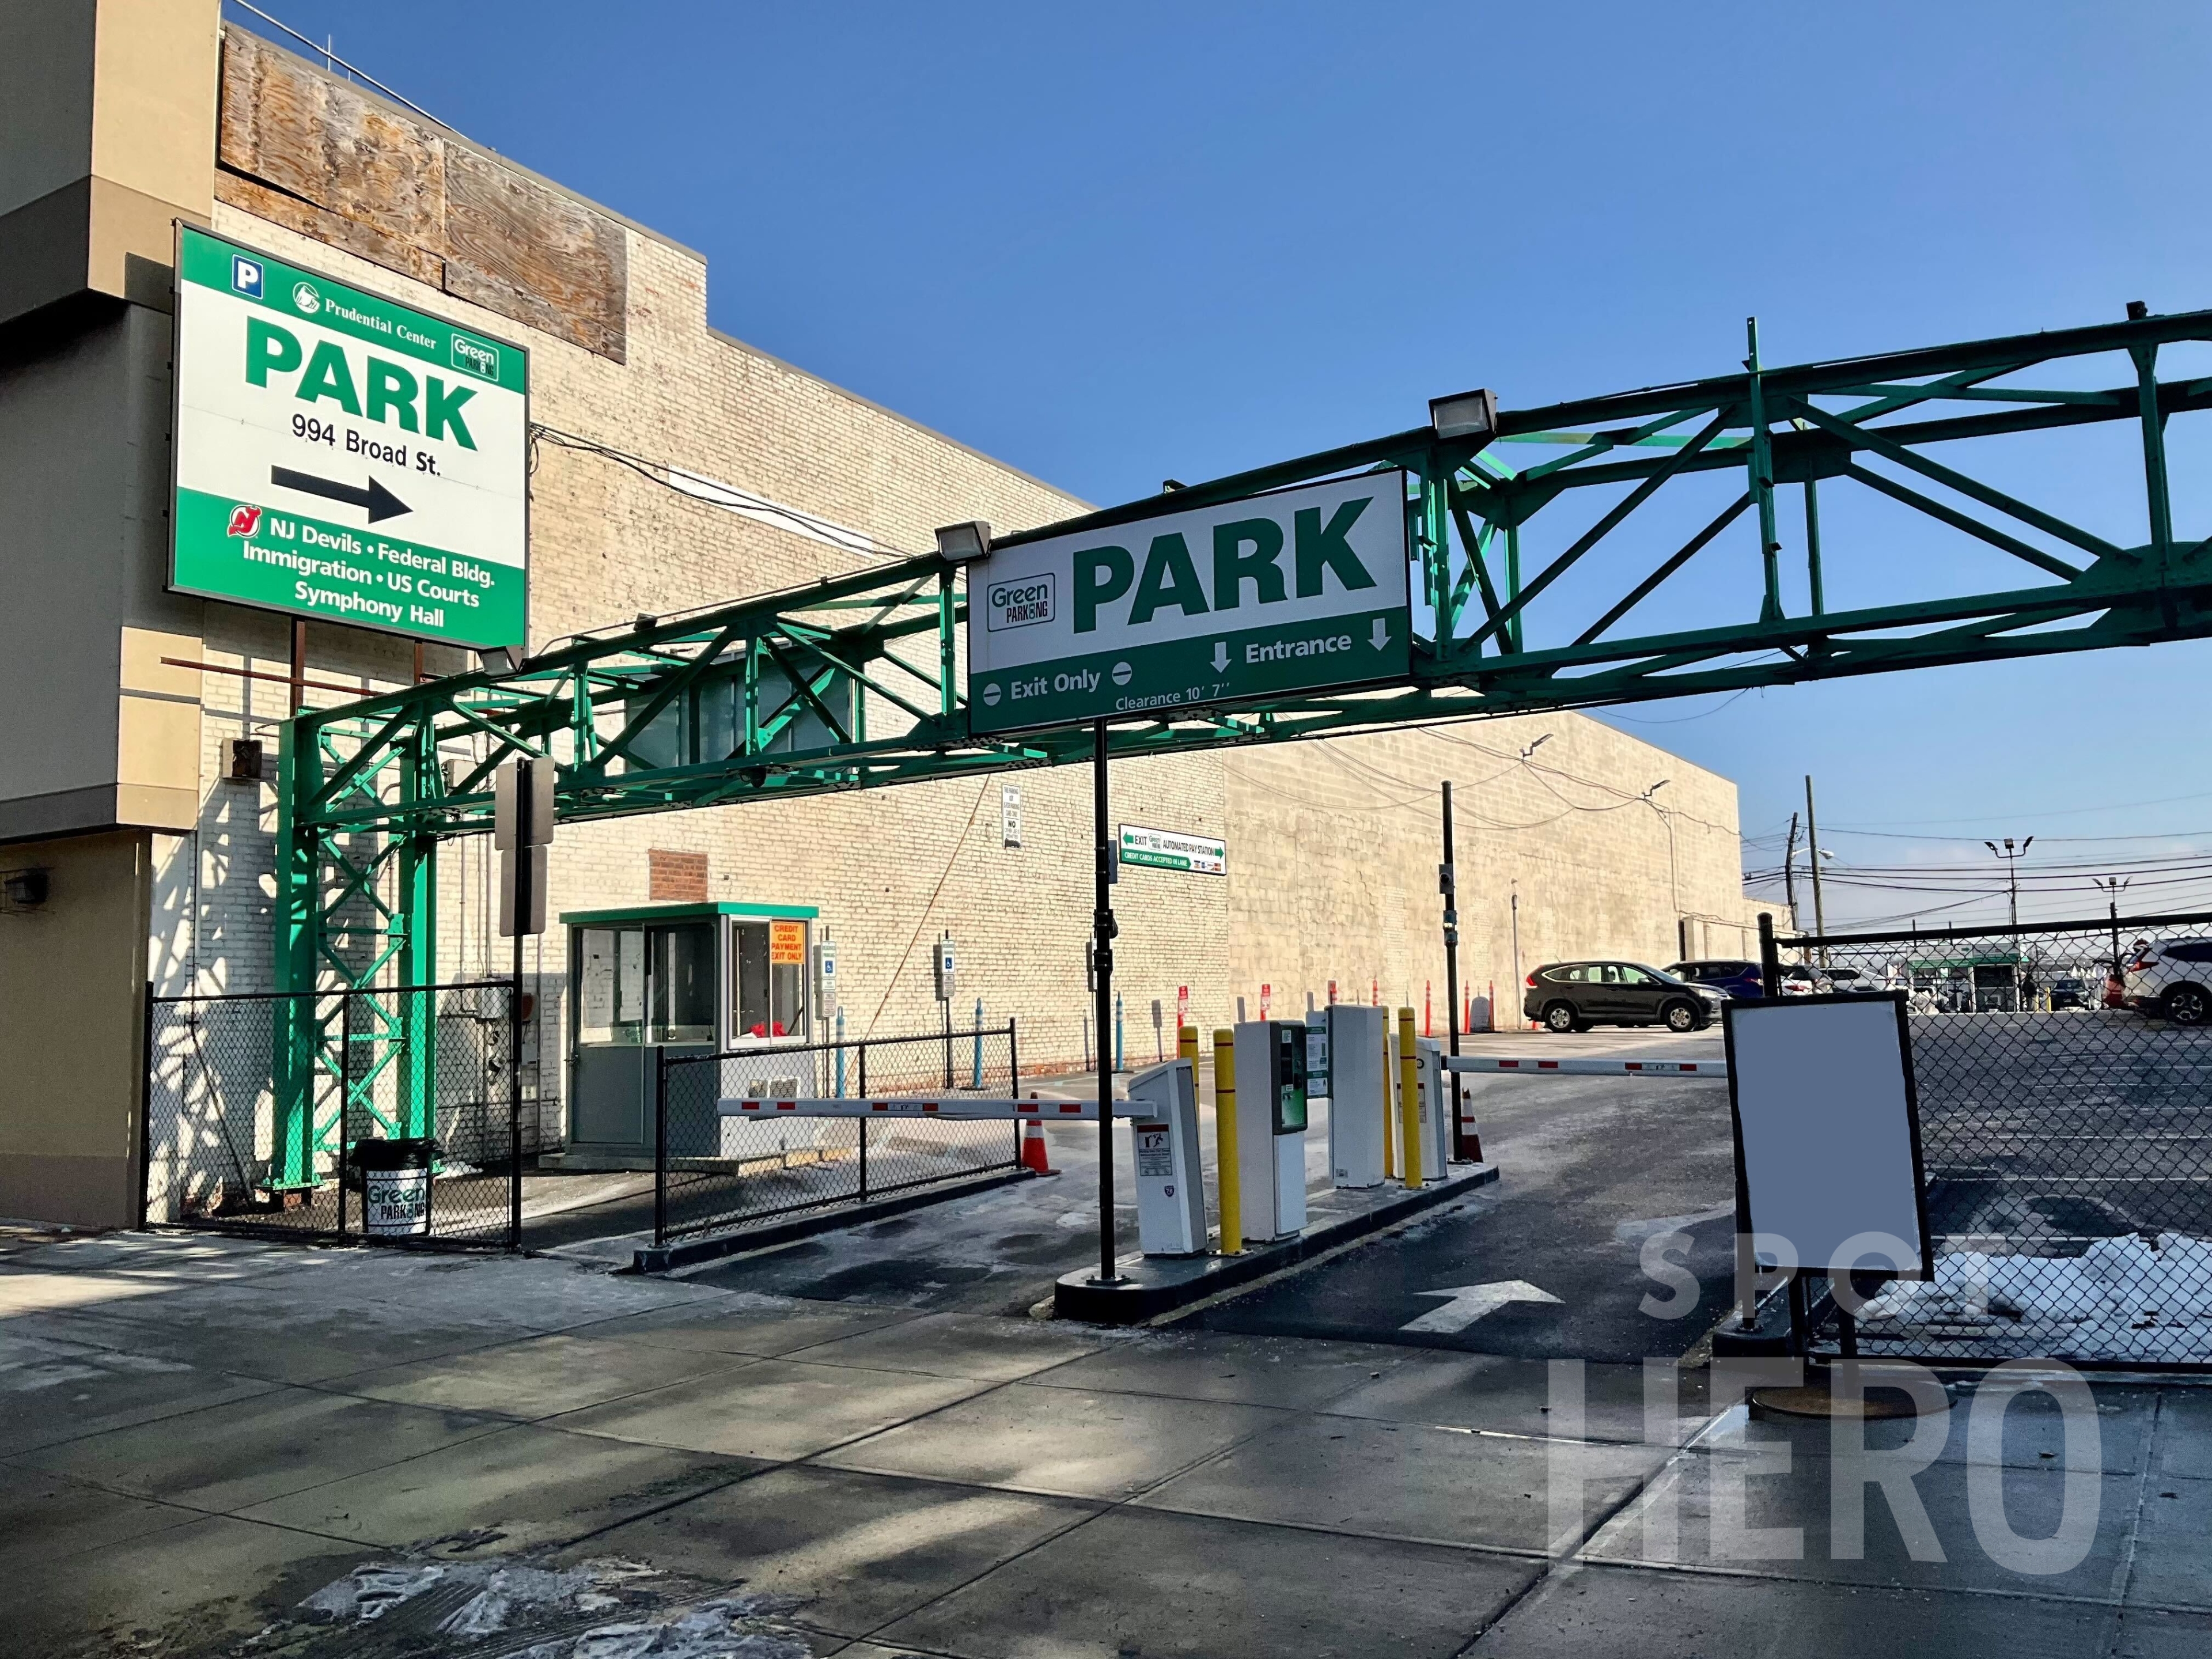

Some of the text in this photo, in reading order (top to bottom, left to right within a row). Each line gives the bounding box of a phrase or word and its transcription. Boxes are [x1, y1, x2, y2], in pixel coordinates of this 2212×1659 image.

[237, 260, 259, 289] P
[324, 298, 437, 350] Prudential Center
[454, 339, 494, 365] Green
[245, 315, 478, 452] PARK
[292, 413, 441, 476] 994 Broad St.
[271, 517, 495, 589] NJ Devils Federal Bldg.
[1073, 496, 1377, 634] PARK
[243, 540, 480, 608] Immigration US Courts
[295, 581, 444, 627] Symphony Hall
[991, 584, 1048, 608] Green
[1245, 634, 1352, 664] Entrance
[1011, 669, 1101, 699] Exit Only
[1115, 691, 1181, 711] Clearance
[1135, 835, 1147, 846] EXIT
[1163, 840, 1188, 851] AUTOMATED
[1198, 845, 1214, 856] STATION
[1153, 855, 1173, 864] ACCEPTED
[772, 942, 802, 950] PAYMENT
[772, 952, 802, 960] EXIT ONLY
[368, 1185, 425, 1203] Green
